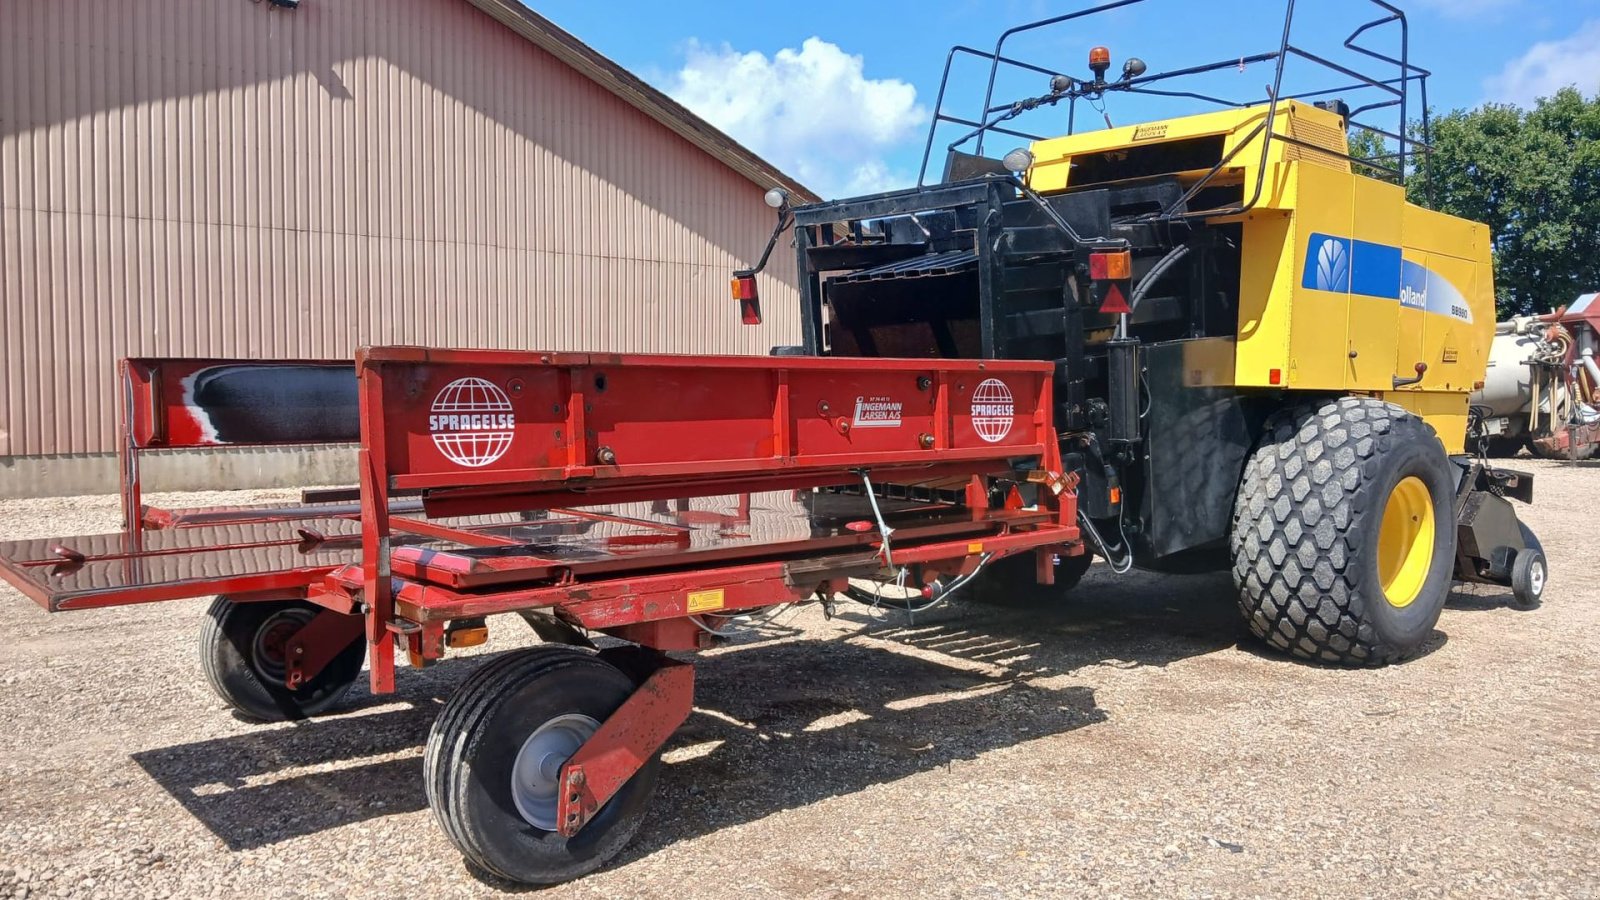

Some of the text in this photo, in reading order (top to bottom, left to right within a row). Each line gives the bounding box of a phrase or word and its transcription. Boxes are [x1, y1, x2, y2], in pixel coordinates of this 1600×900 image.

[861, 402, 903, 411] INGEMANN
[971, 404, 1014, 416] SPRAGELSE
[860, 411, 901, 420] LARSEN A/S
[429, 414, 515, 431] SPRAGELSE
